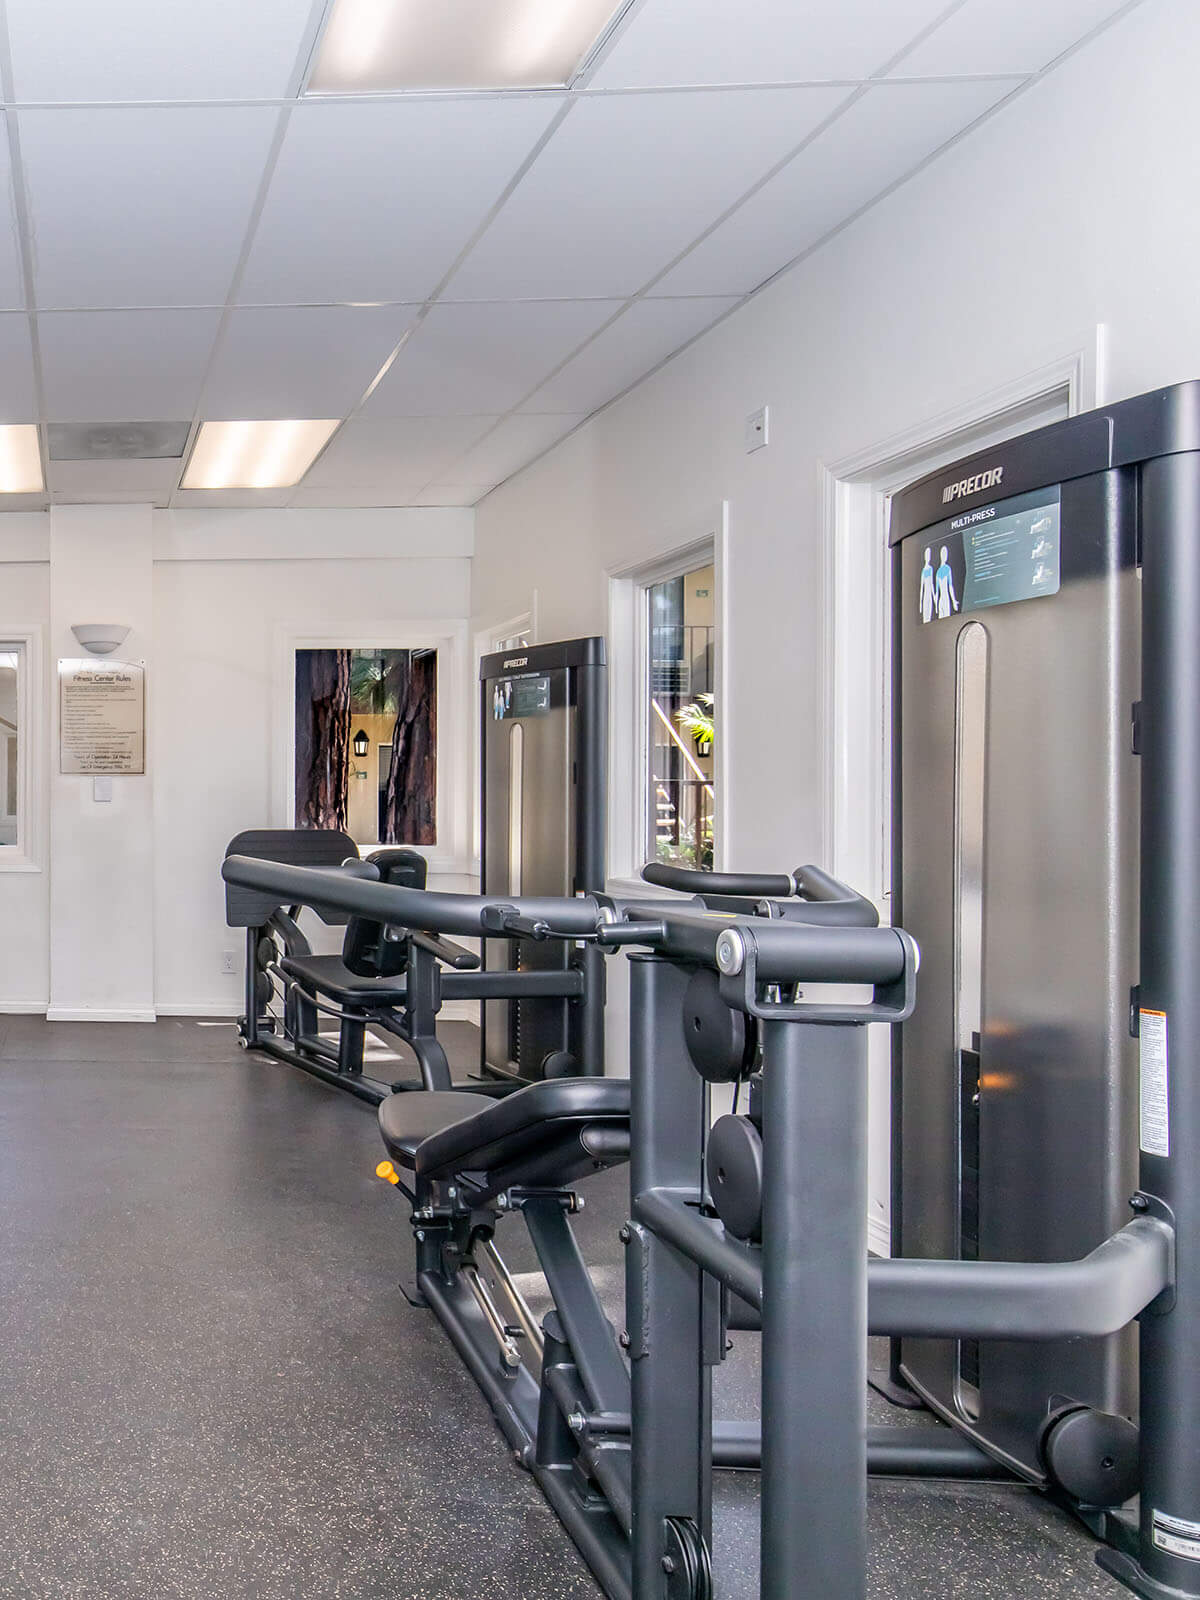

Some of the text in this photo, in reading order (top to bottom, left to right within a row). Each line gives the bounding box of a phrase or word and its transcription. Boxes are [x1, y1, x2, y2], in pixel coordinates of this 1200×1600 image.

[949, 466, 1003, 501] PRECOR
[951, 507, 996, 530] MULTI-PRESS
[73, 674, 132, 682] Fitness Center Rules
